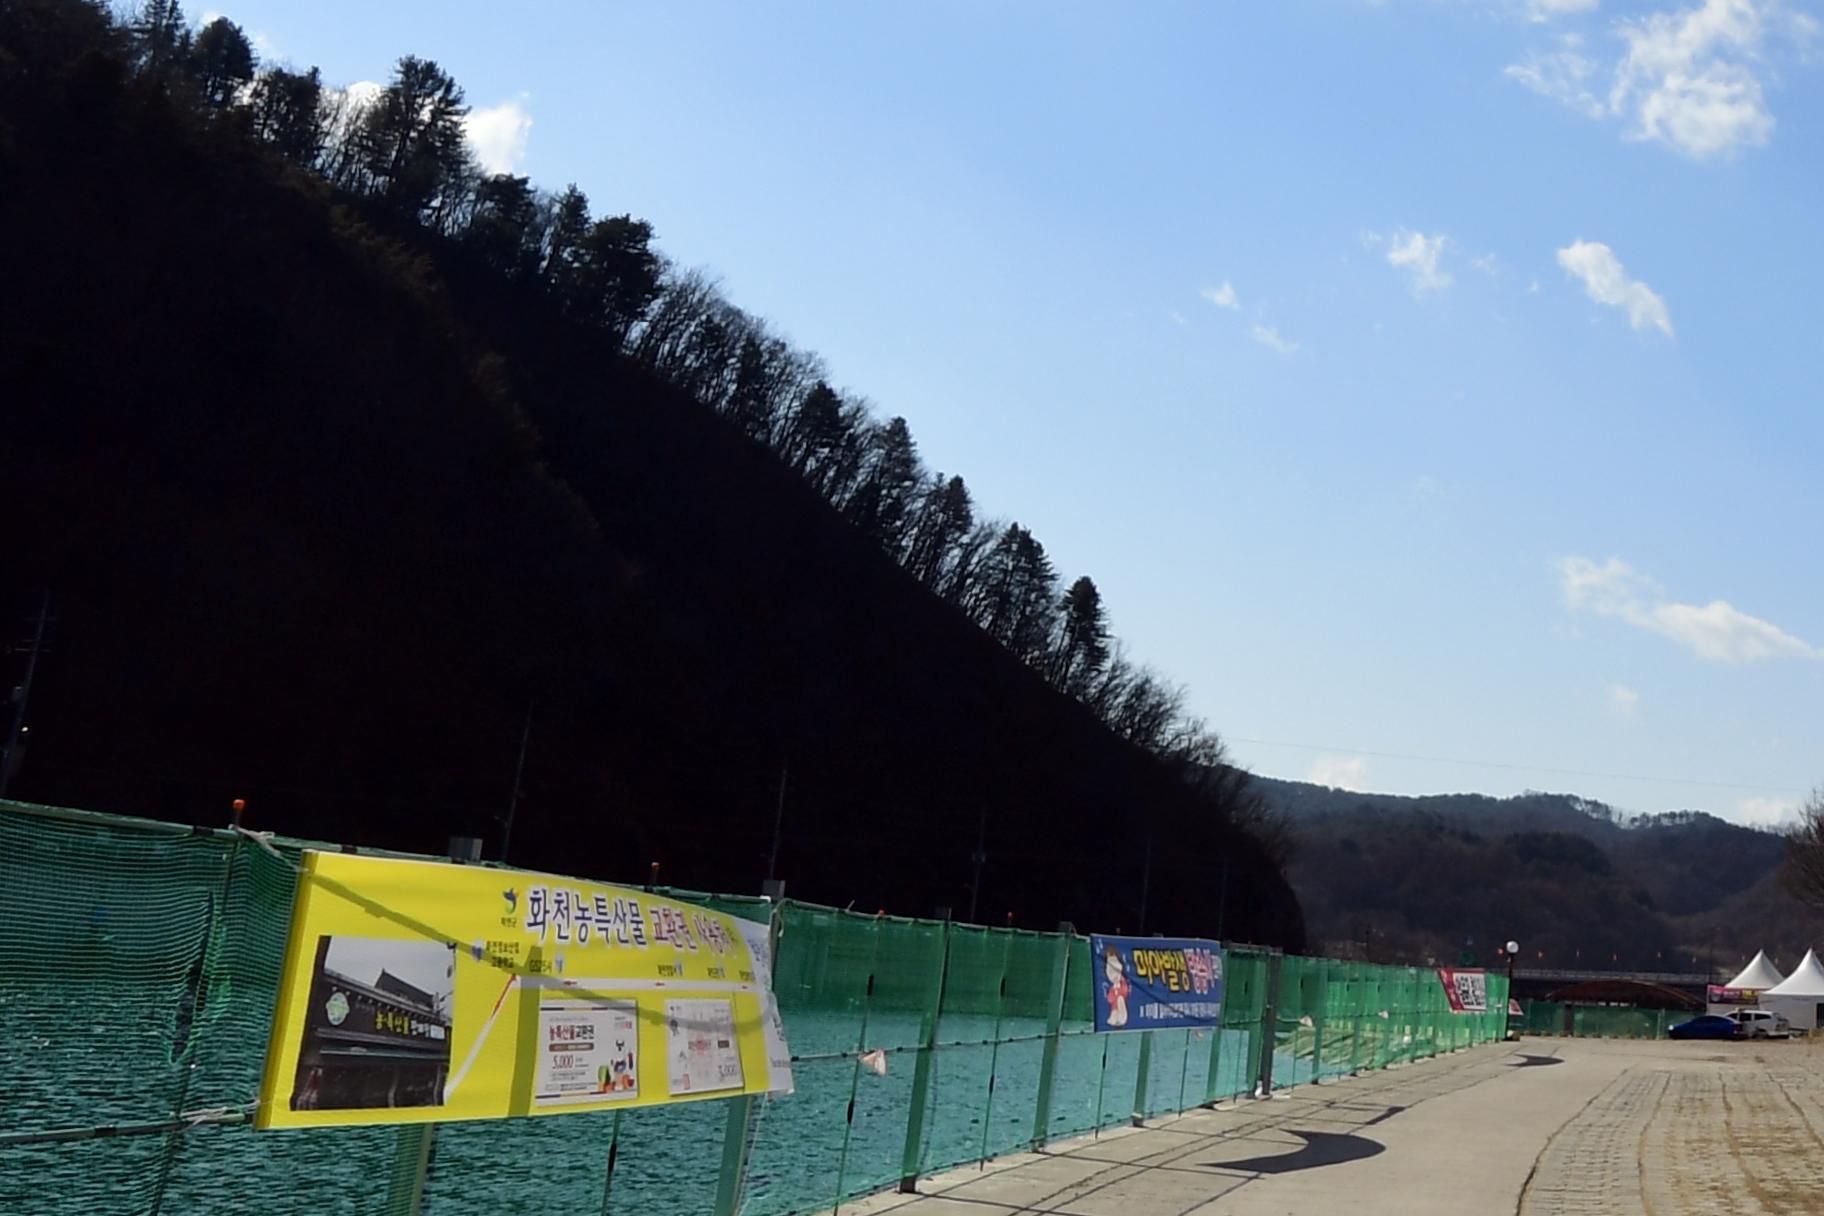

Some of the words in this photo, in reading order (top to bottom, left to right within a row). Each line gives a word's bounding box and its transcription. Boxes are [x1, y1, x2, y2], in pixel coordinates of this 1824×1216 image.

[526, 887, 648, 946] 화천농특산물
[649, 906, 698, 950] 교환권
[1132, 949, 1190, 992] 미아발생
